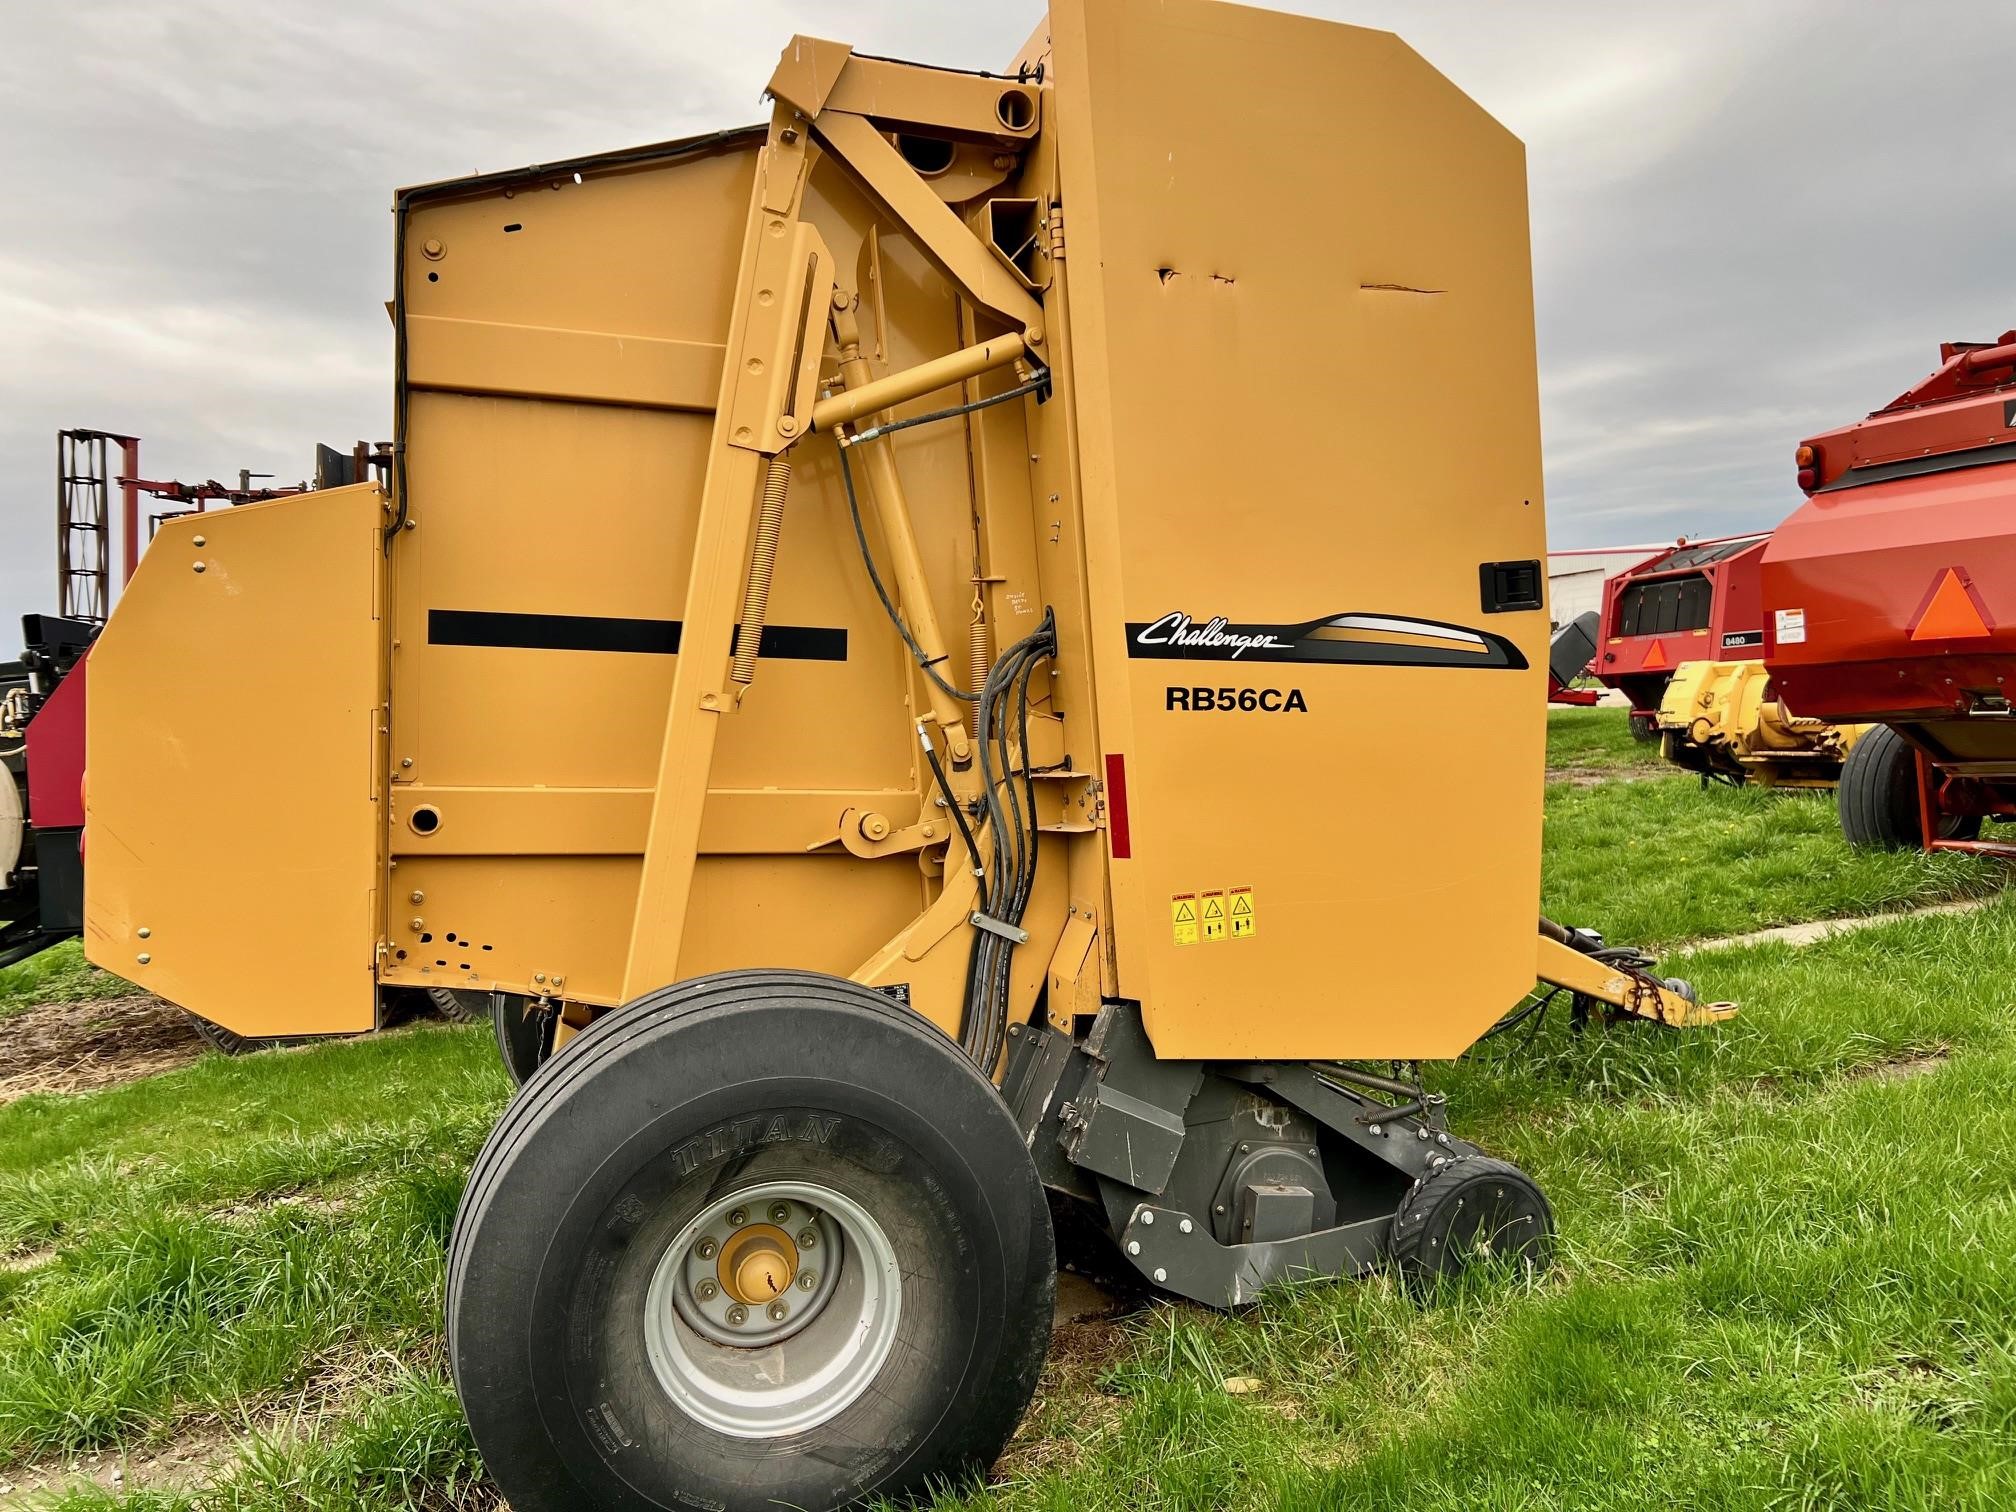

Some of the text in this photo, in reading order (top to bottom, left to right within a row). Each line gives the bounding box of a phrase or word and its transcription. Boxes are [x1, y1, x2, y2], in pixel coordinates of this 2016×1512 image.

[1137, 612, 1296, 659] Challenger
[1725, 636, 1745, 645] 8480
[1165, 686, 1308, 713] RB56CA
[670, 1114, 842, 1177] TITAN
